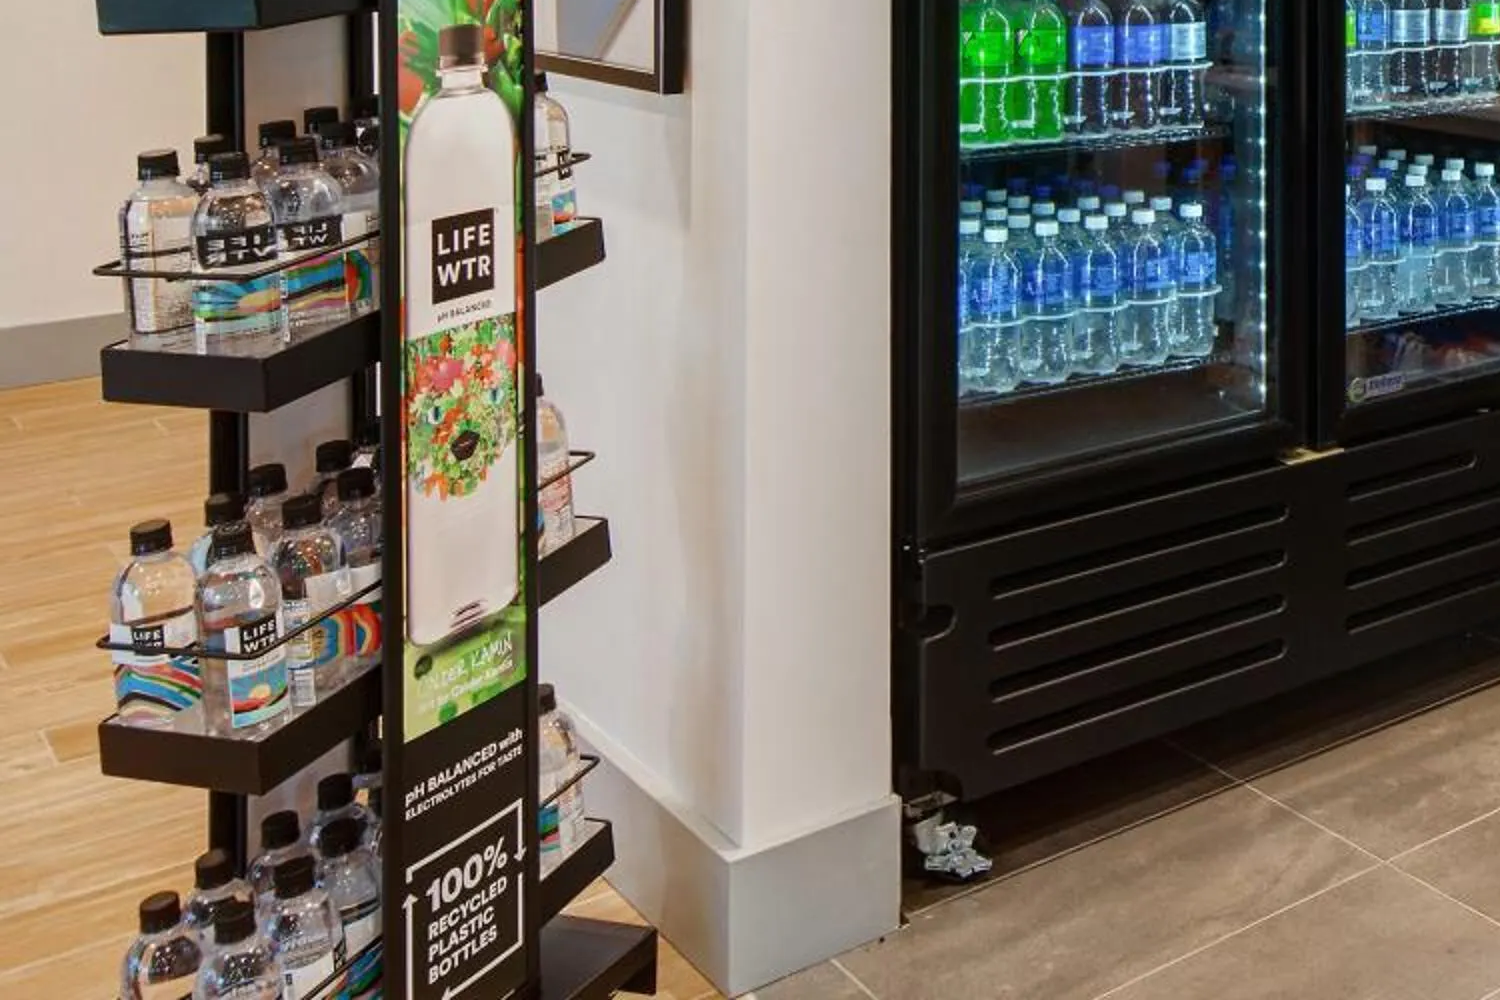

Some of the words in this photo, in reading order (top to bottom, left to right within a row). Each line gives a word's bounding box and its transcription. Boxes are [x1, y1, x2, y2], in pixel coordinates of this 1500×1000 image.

[437, 223, 491, 256] LIFE
[437, 255, 491, 287] WTR
[133, 630, 161, 641] LIFE
[243, 618, 276, 641] LIFE
[405, 781, 425, 807] pH
[427, 743, 497, 792] BALANCED
[499, 727, 523, 749] with
[405, 773, 477, 821] ELECTROLYTES
[477, 761, 497, 780] FOR
[498, 743, 523, 767] TASTE
[426, 836, 508, 912] 100%
[428, 876, 508, 940] RECYCLED
[428, 906, 495, 962] PLASTIC
[428, 925, 498, 984] BOTTLES
